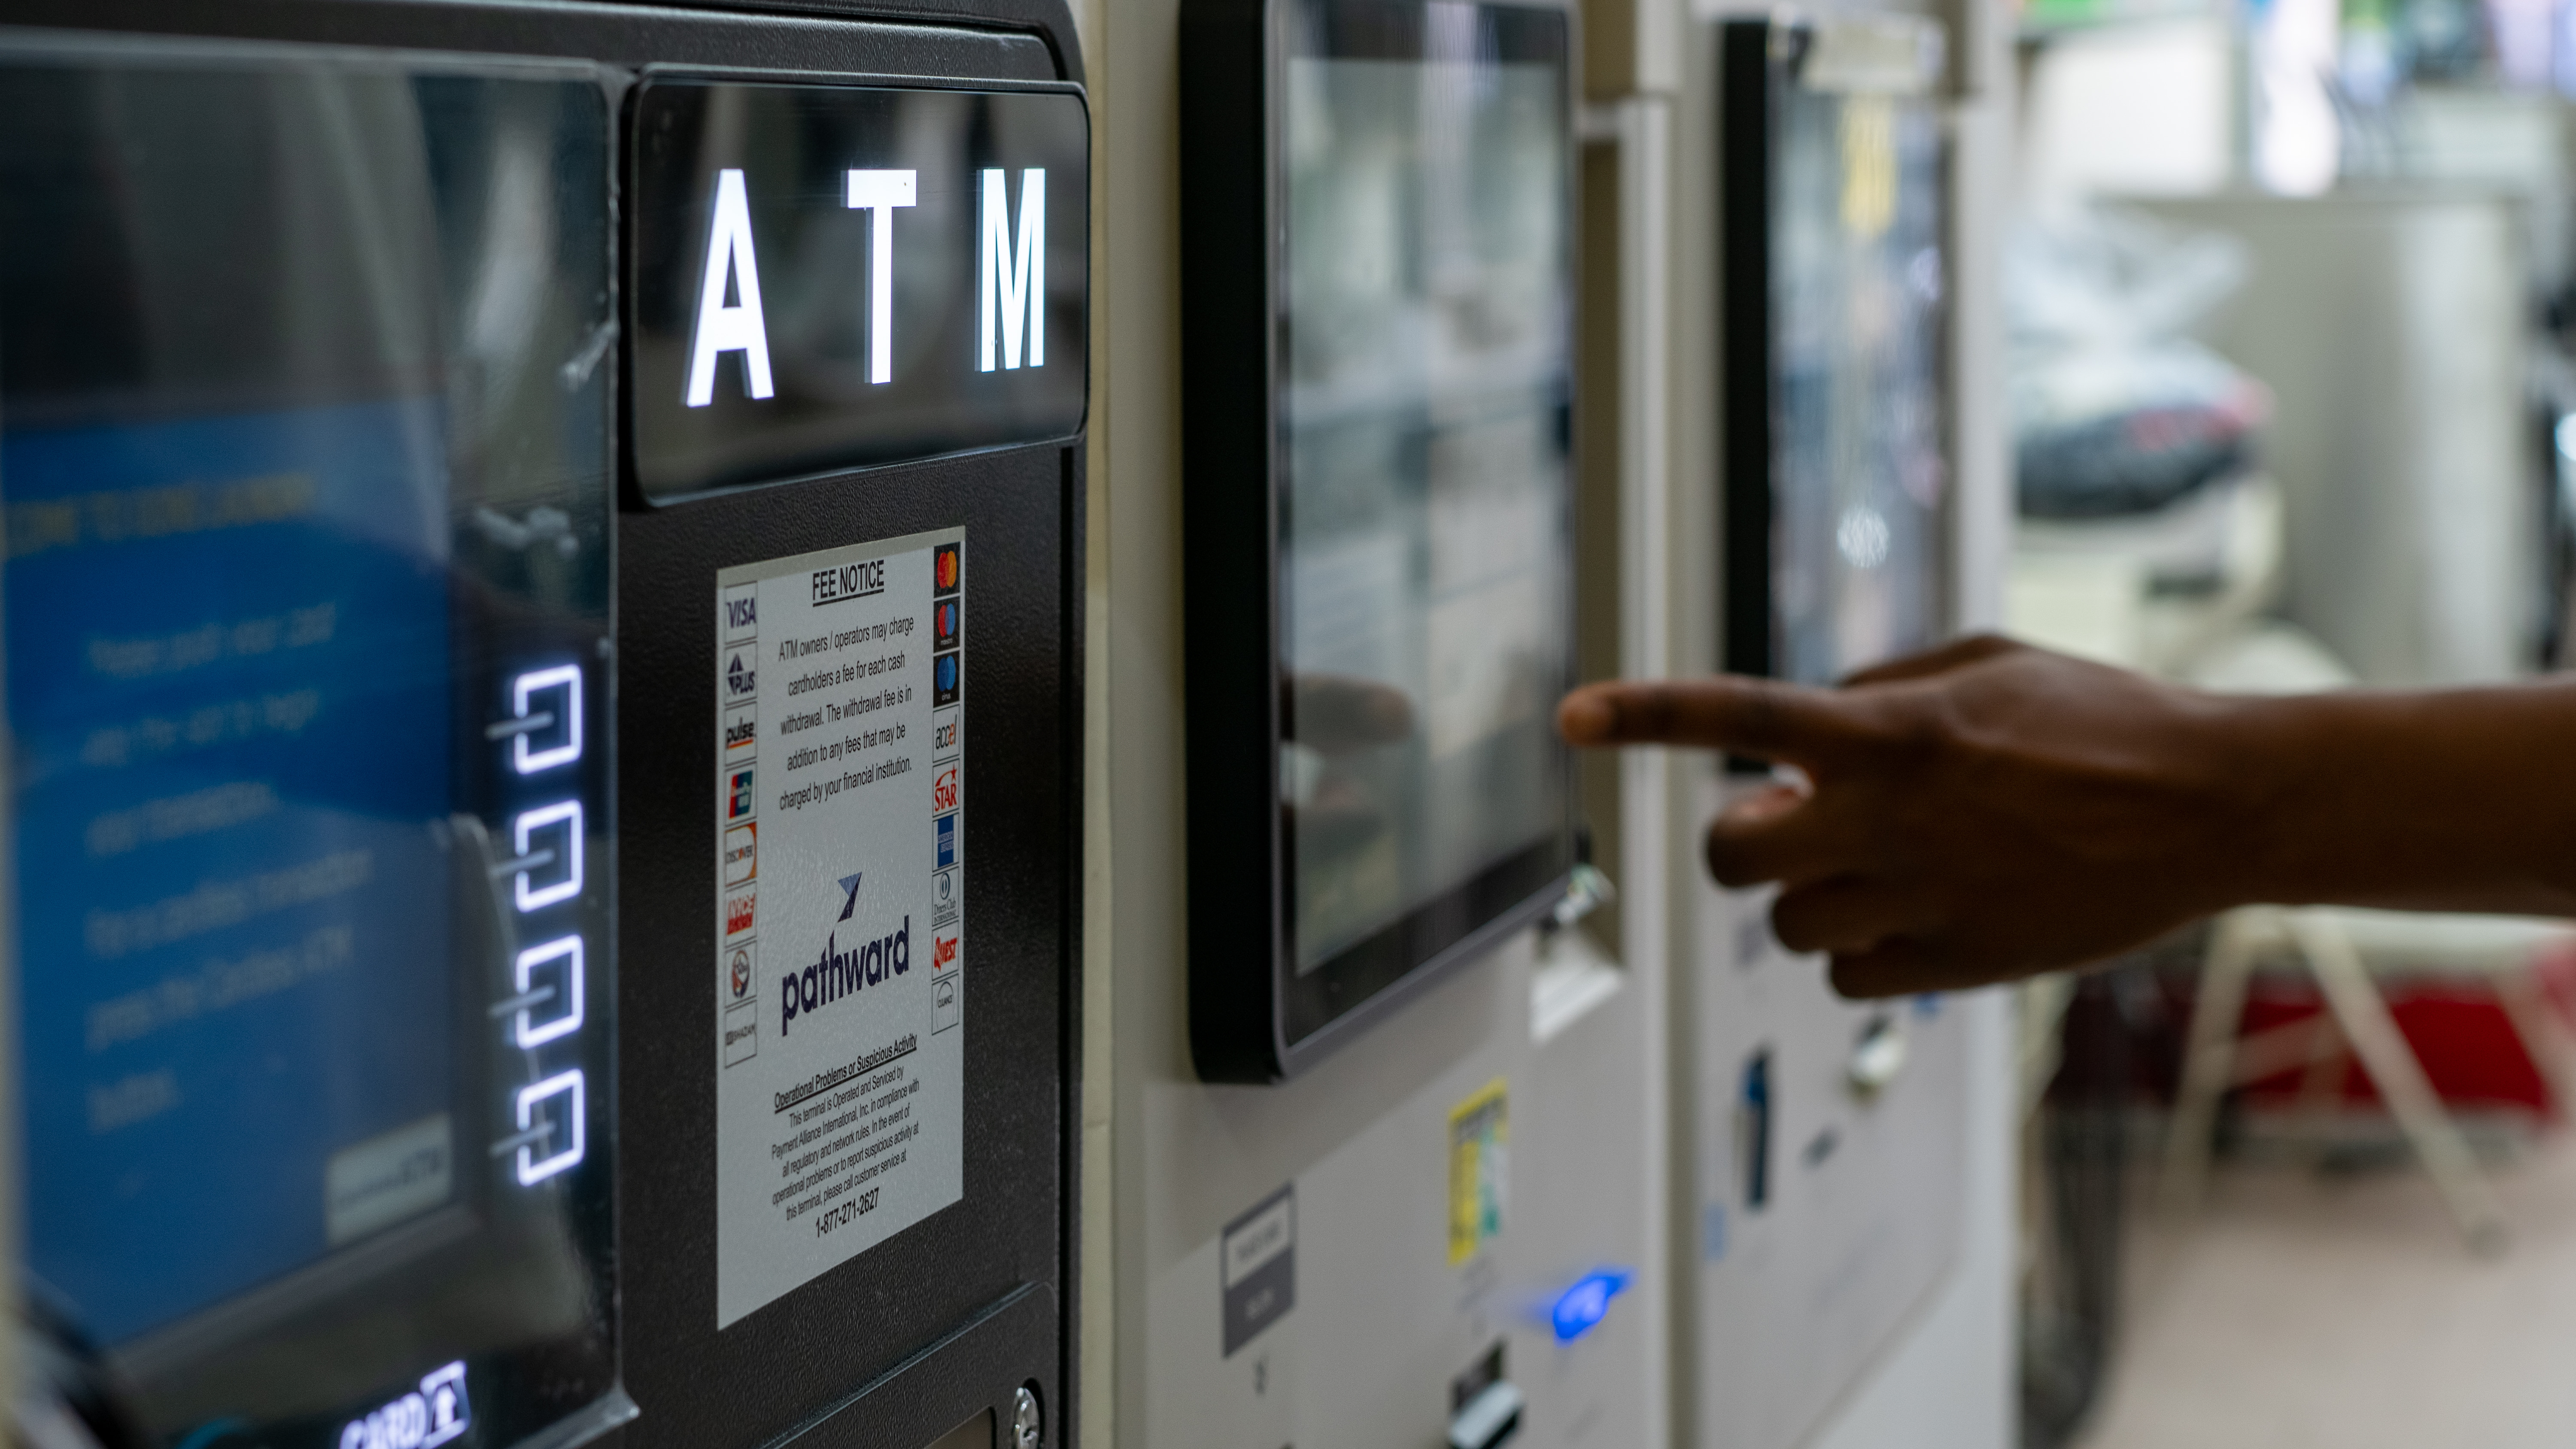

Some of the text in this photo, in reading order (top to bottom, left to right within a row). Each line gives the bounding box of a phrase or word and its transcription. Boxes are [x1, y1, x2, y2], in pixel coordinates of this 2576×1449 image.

[812, 559, 884, 601] FEE NOTICE
[725, 597, 757, 628] VISA
[778, 616, 914, 662] ATM owners / operators may charge
[735, 670, 756, 694] PLUS
[788, 650, 905, 697] cardholders a fee for each cash
[780, 683, 911, 736] withdrawal. The withdrawal fee is in
[936, 714, 957, 750] accel
[787, 721, 905, 771] addition to any fees that may be
[779, 782, 811, 811] charged
[813, 781, 823, 804] by
[824, 778, 842, 802] your
[843, 764, 874, 791] financial
[876, 755, 912, 781] institution.
[935, 782, 957, 812] STAR
[782, 914, 909, 1037] pathward
[774, 1033, 917, 1109] Operational Problems or Suspicious Activity
[789, 1064, 904, 1128] This terminal is Operated and Serviced by
[772, 1077, 920, 1160] Payment Alliance International, Inc. in compliance with
[790, 1149, 820, 1175] regulatory
[820, 1140, 832, 1159] and
[832, 1130, 855, 1154] network
[856, 1124, 871, 1142] rules.
[872, 1119, 878, 1134] In
[878, 1116, 887, 1131] the
[888, 1106, 904, 1126] event
[904, 1102, 910, 1119] of
[772, 1120, 919, 1207] operational problems or to report suspicious activity at
[786, 1147, 907, 1222] this terminal, please call customer service at
[816, 1186, 879, 1238] 1-877-271-2627
